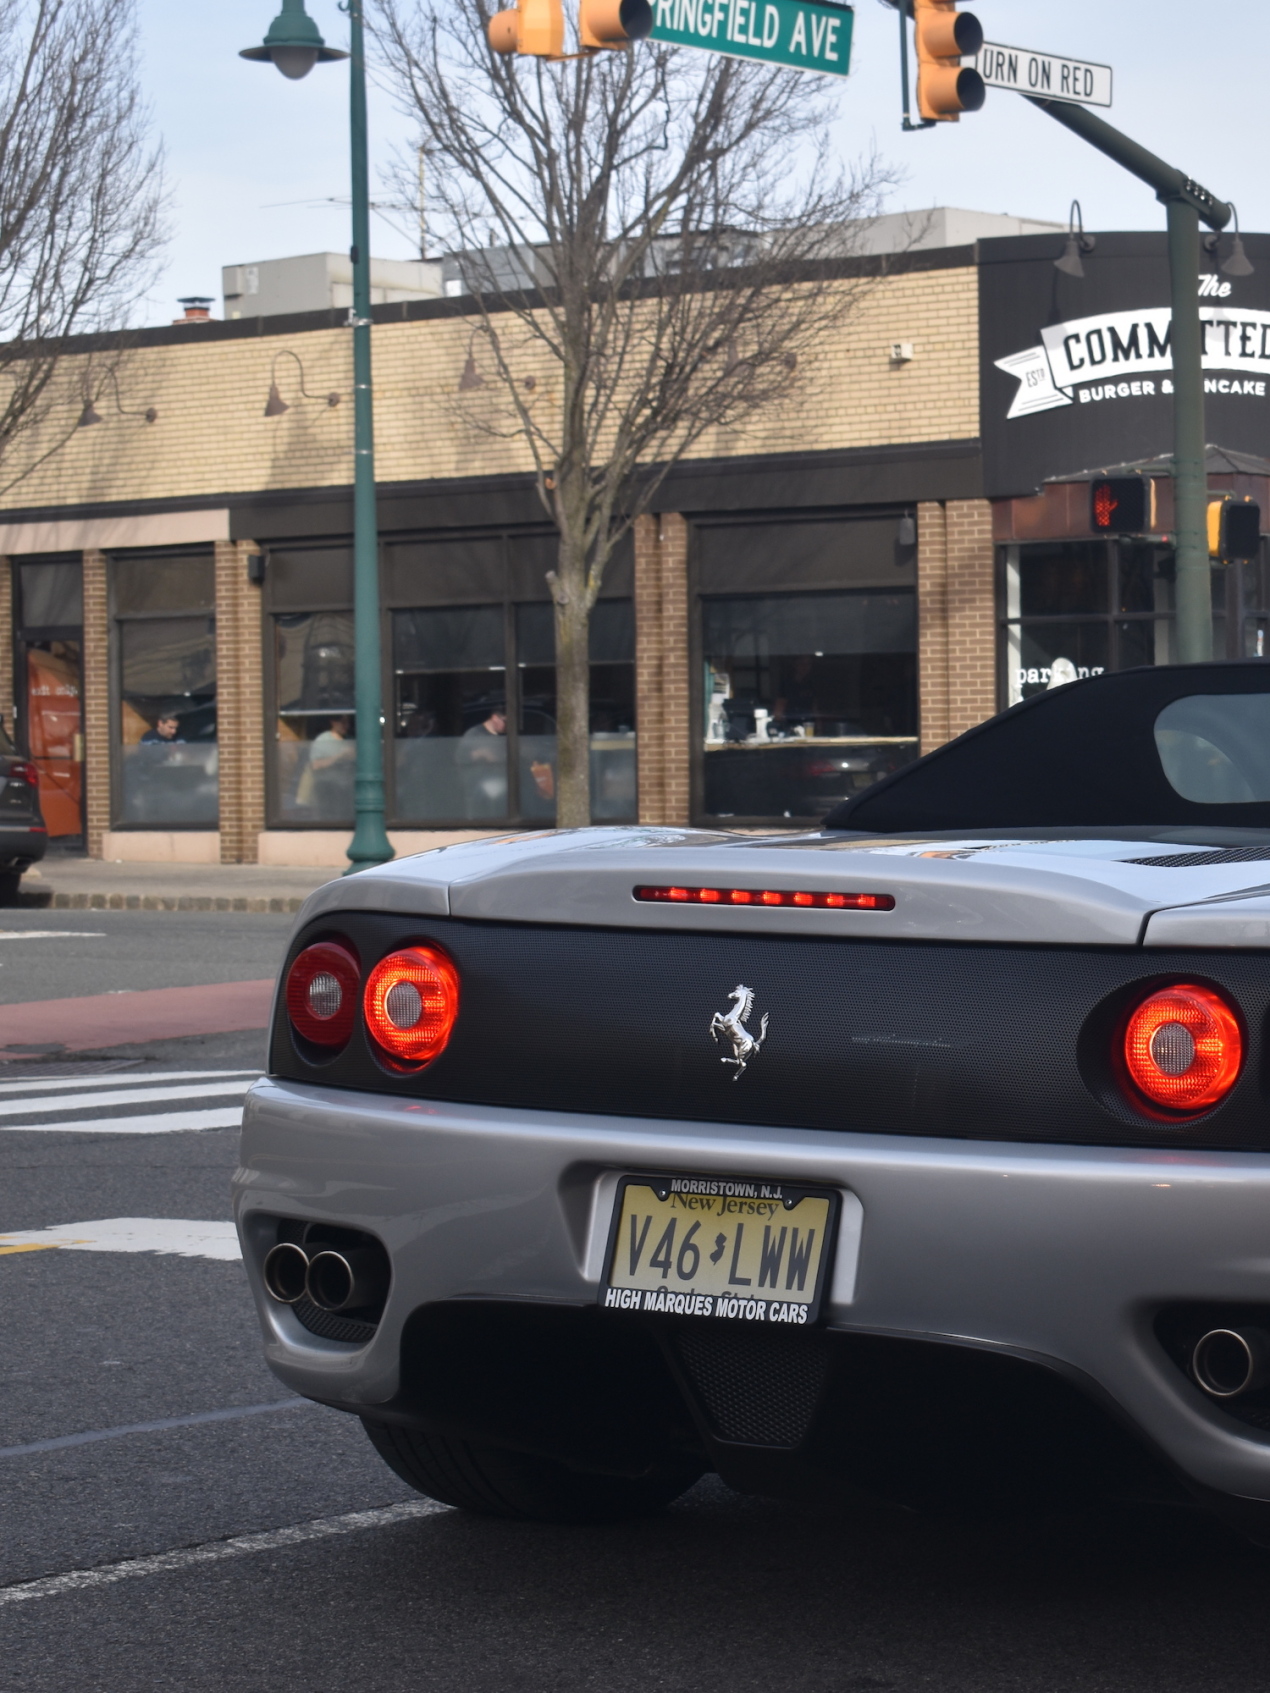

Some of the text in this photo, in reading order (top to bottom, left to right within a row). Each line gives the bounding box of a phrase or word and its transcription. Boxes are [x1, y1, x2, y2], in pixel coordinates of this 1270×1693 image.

[789, 11, 841, 62] AVE
[976, 47, 1094, 97] URN ON RED
[1198, 273, 1232, 297] The
[1079, 380, 1155, 403] BURGER
[1161, 379, 1174, 394] &
[1203, 378, 1266, 396] NCAKE
[671, 1179, 783, 1199] MORRISTOWN, N.J.
[671, 1193, 779, 1221] New Jersey
[629, 1214, 815, 1292] V46 LWW
[605, 1288, 642, 1310] HIGH
[643, 1292, 713, 1316] MARQUES
[715, 1298, 766, 1321] MOTOR
[769, 1302, 808, 1325] CARS
